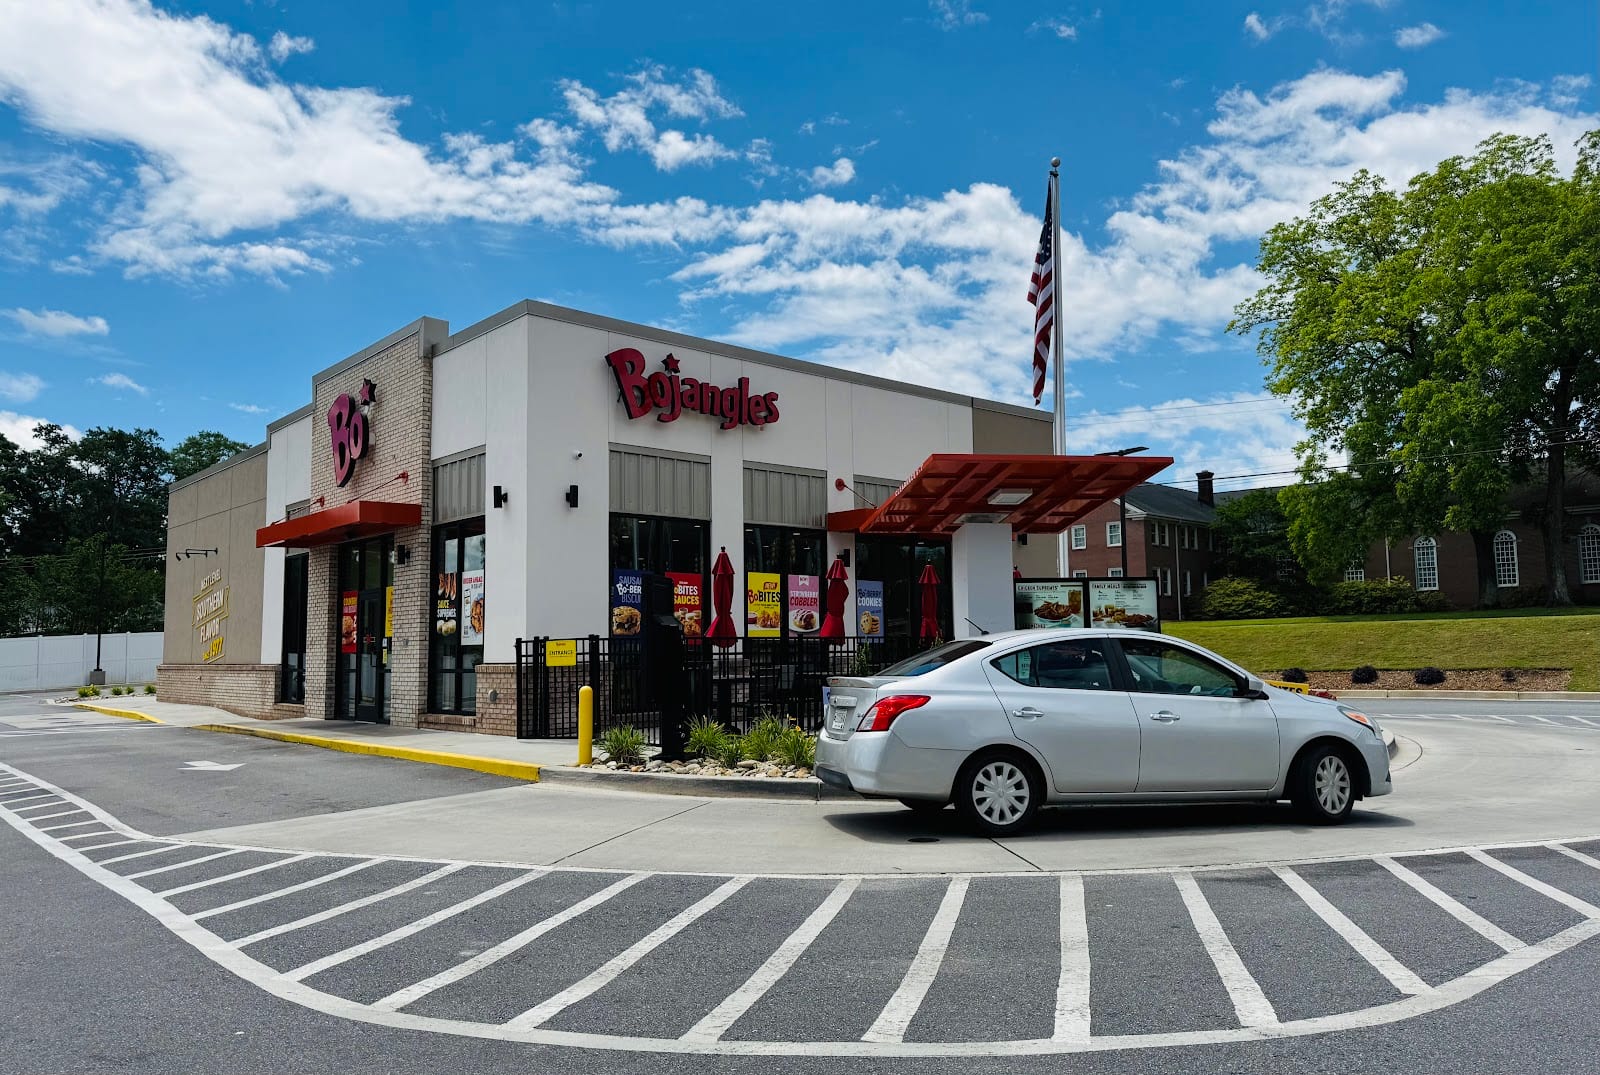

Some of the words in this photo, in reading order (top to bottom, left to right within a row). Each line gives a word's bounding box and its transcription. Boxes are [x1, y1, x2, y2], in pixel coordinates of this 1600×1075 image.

[605, 348, 780, 430] Bojangles
[618, 575, 642, 585] SAUSA
[197, 588, 224, 621] SOUTHERN
[621, 594, 641, 603] BISCU
[790, 597, 818, 607] COBBLER
[857, 598, 882, 607] COOKIES
[201, 618, 220, 643] FLAVOR
[209, 637, 224, 656] 1977
